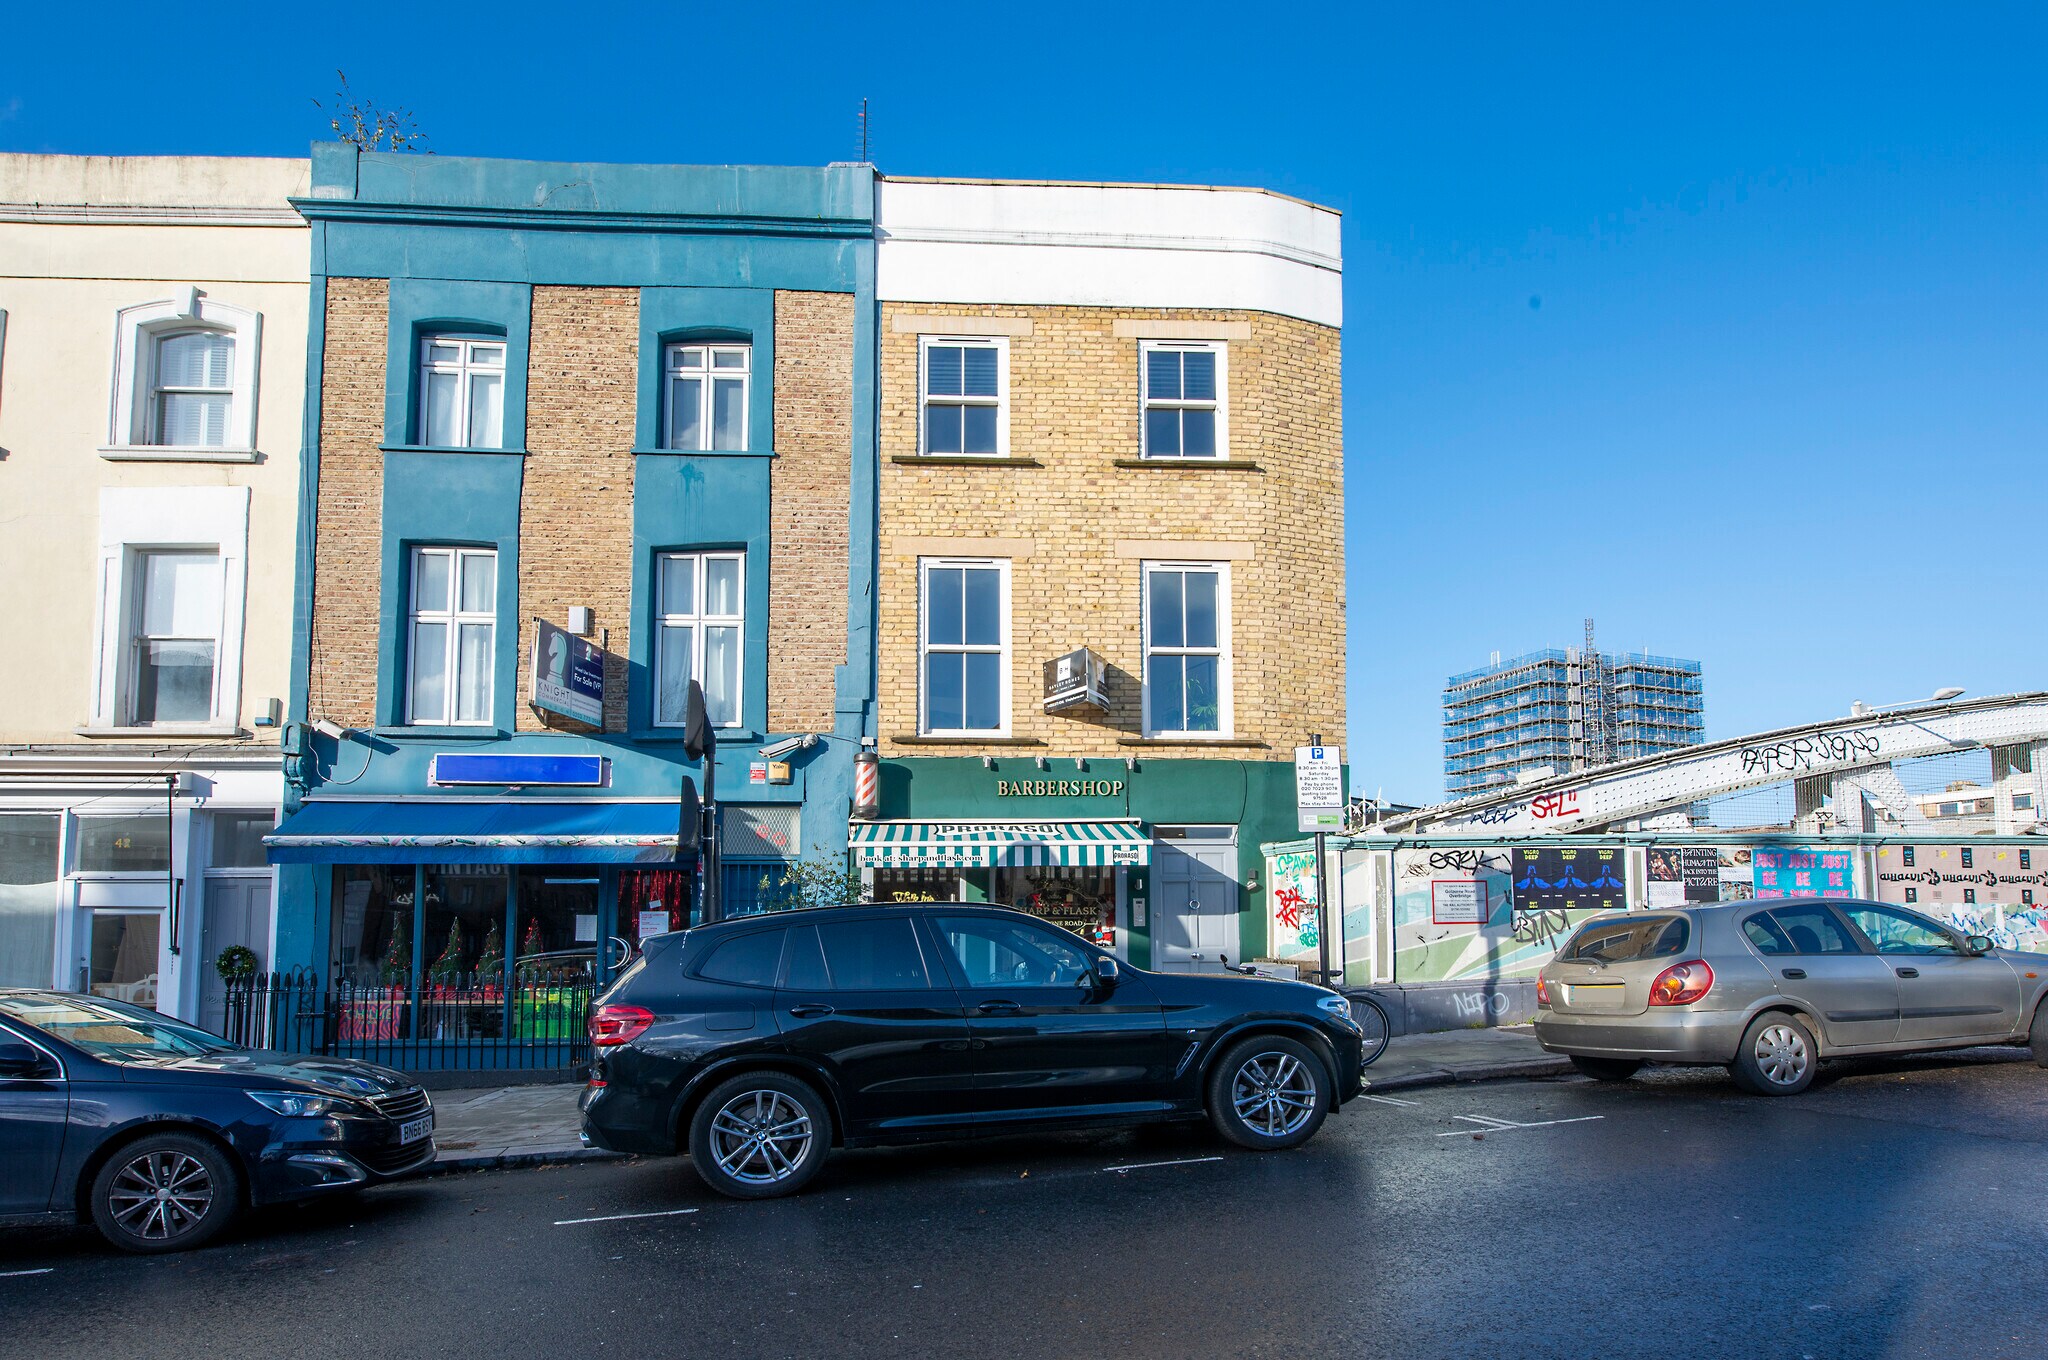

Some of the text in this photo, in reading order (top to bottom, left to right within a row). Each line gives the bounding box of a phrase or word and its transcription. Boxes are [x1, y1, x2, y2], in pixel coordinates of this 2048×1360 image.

[574, 672, 582, 683] For
[582, 676, 593, 687] Sale
[538, 681, 570, 700] KNIGHT
[997, 780, 1125, 797] BARBERSHOP
[942, 824, 1055, 834] PRORASO
[860, 852, 983, 864] book at: sharpandflask.com
[1755, 853, 1848, 869] JUST JUST JUST
[1762, 871, 1777, 885] BE
[1795, 871, 1811, 886] BE
[1828, 872, 1843, 886] BE
[1063, 907, 1097, 915] FLASK
